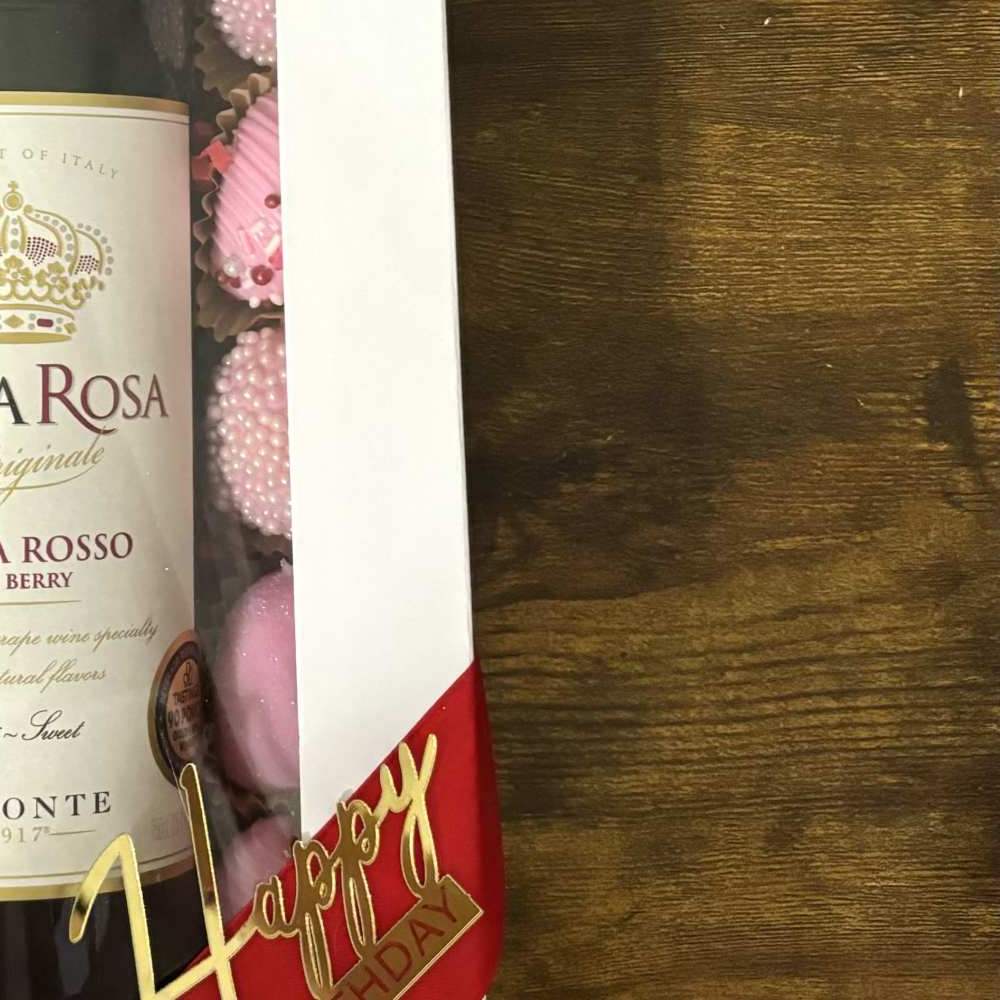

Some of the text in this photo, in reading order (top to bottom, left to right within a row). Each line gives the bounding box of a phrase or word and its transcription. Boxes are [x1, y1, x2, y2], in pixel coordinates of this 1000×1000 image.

[21, 148, 49, 161] OF
[61, 152, 120, 179] ITALY
[36, 363, 169, 435] ROSA
[22, 532, 134, 563] ROSSO
[6, 571, 73, 589] BERRY
[46, 628, 91, 645] wine
[92, 617, 158, 652] specialty
[40, 658, 107, 693] flavors
[69, 733, 438, 1000] Happy
